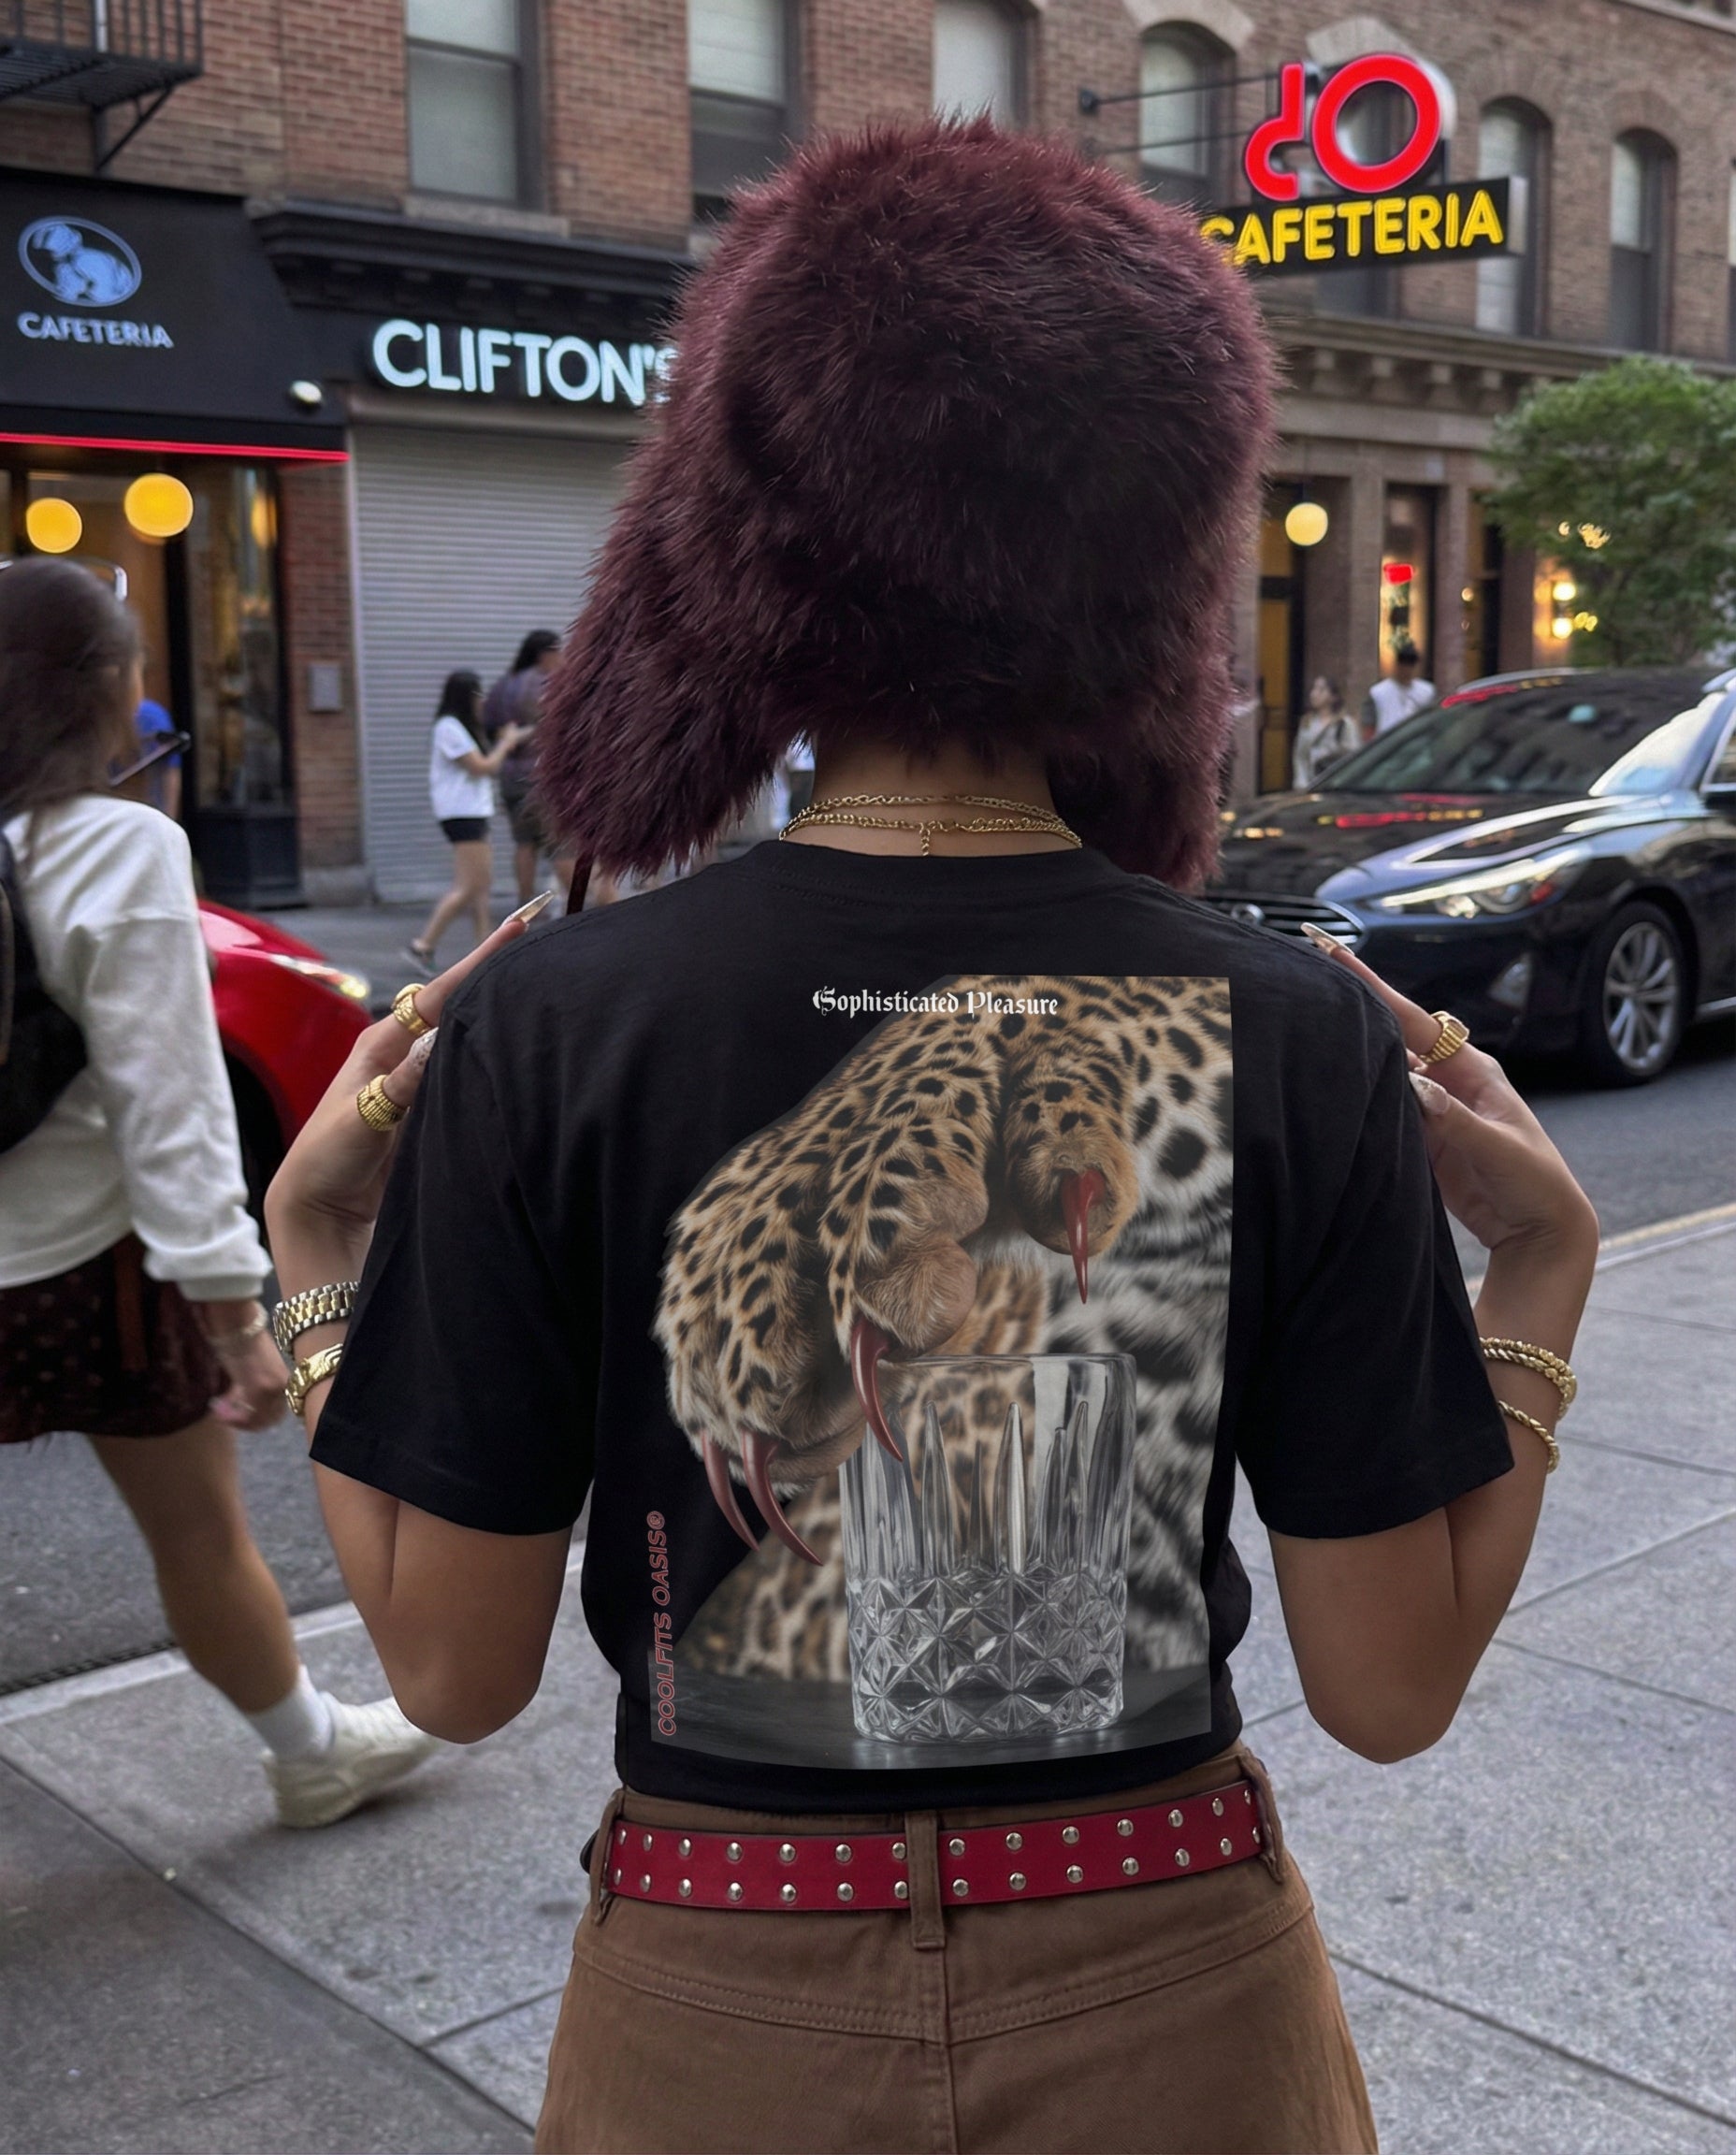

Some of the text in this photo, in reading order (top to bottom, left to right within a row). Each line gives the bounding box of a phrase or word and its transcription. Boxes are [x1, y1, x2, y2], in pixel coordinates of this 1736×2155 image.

[17, 311, 175, 349] CAFETERIA
[812, 986, 1059, 1019] Sophisticated Pleasure
[654, 1613, 676, 1736] COOLFITS
